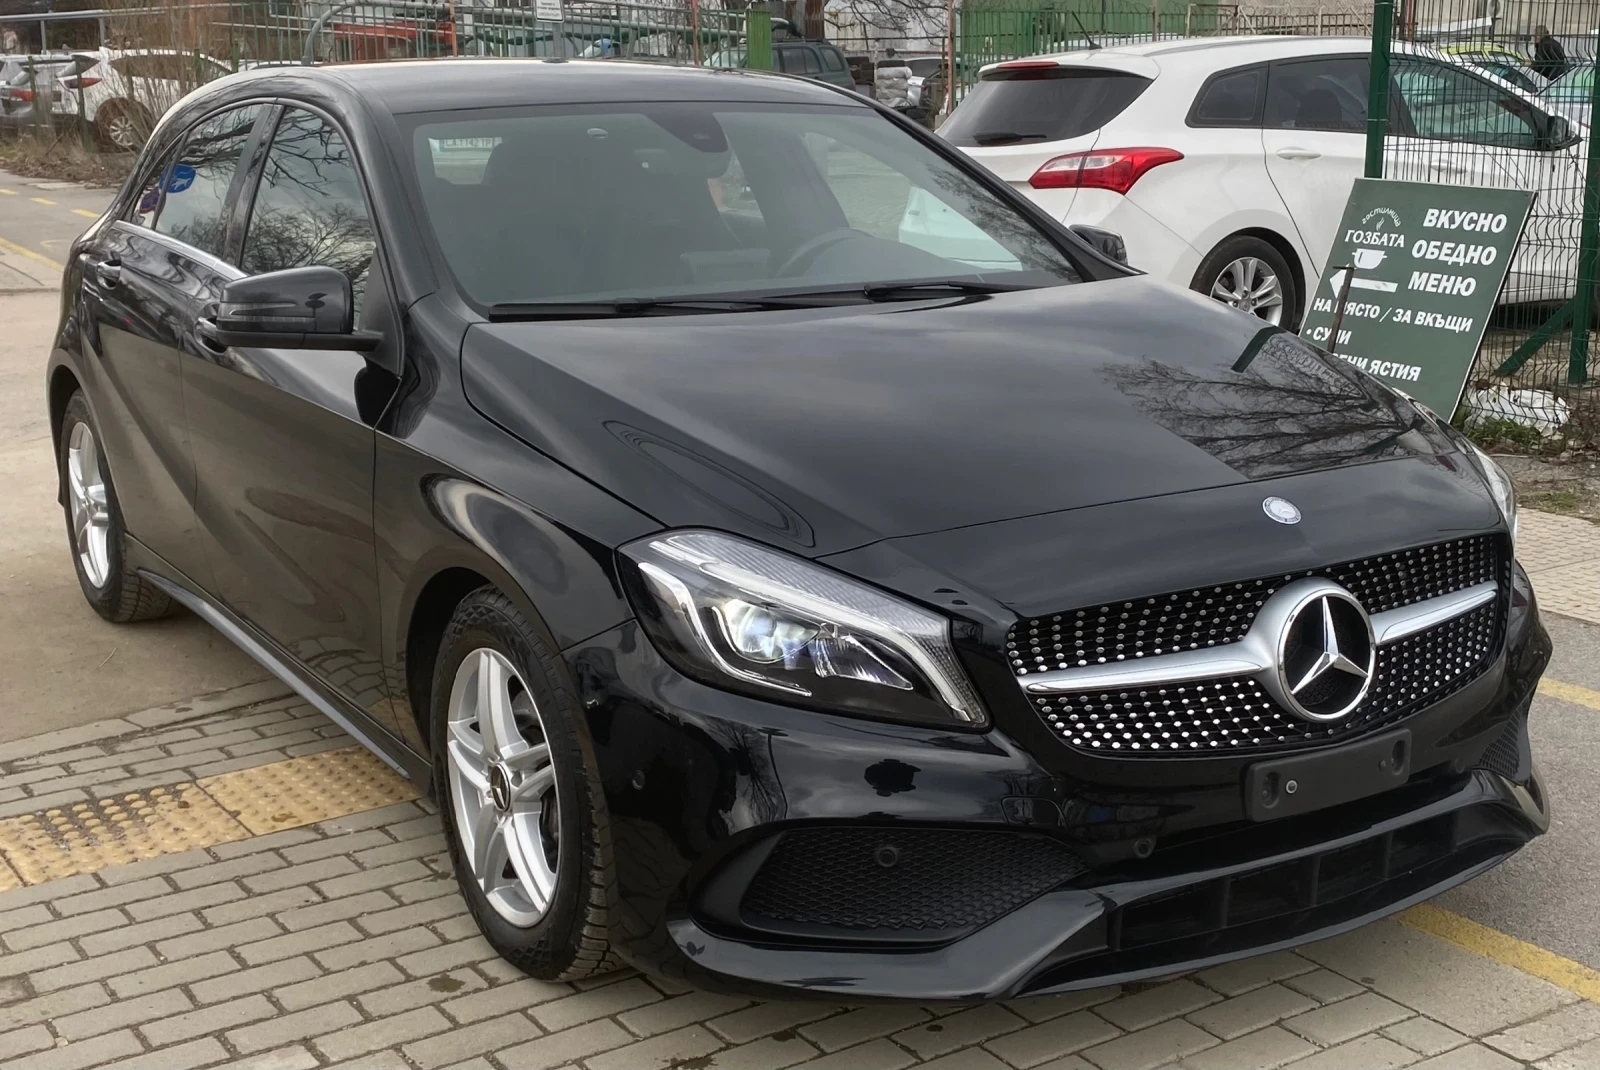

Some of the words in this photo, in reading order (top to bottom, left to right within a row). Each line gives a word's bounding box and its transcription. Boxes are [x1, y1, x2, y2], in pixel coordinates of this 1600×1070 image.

[1423, 208, 1507, 233] ВКУСНО
[1344, 229, 1405, 248] ГОЗБАТА
[1411, 239, 1497, 267] ОБЕДНО
[1407, 271, 1476, 297] МЕНЮ
[1313, 298, 1332, 313] НА
[1392, 308, 1412, 324] ЗА
[1414, 311, 1473, 334] ВКЪЩИ
[1368, 359, 1421, 382] ЯСТИЯ
